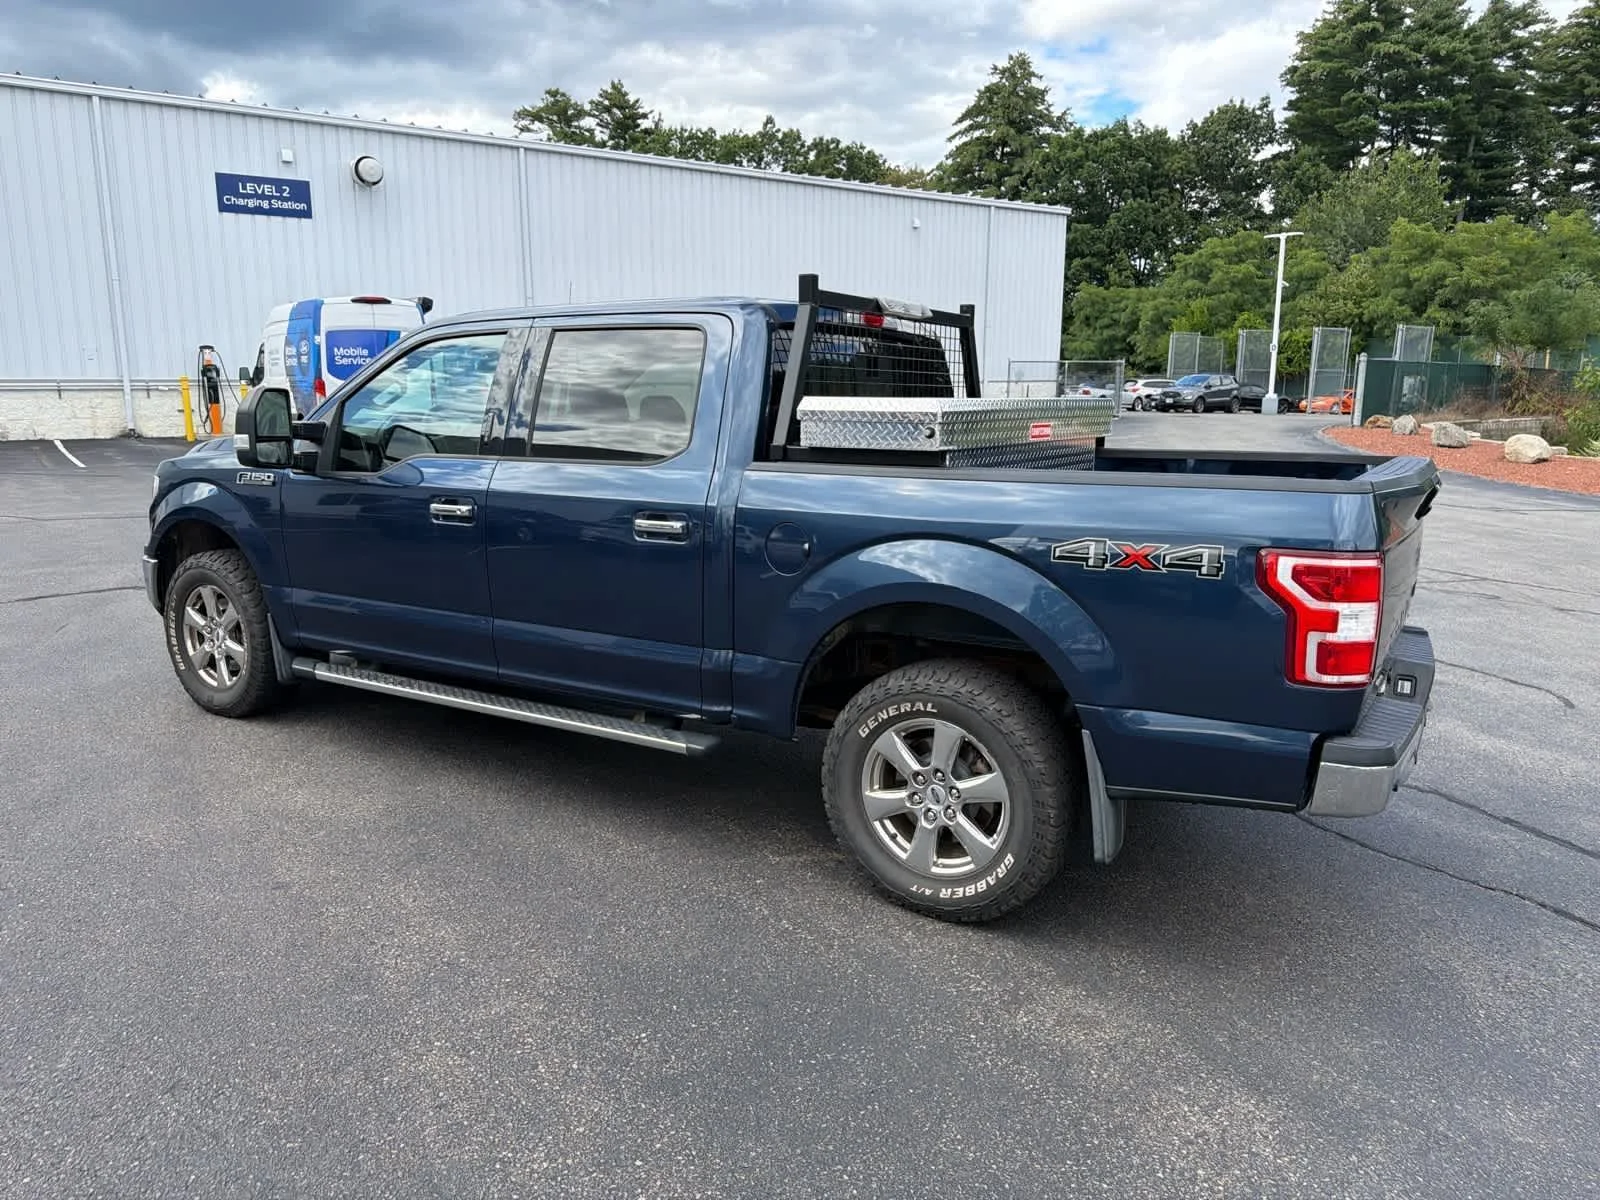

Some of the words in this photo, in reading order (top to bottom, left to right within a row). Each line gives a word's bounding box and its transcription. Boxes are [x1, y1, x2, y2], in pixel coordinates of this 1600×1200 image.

[238, 182, 280, 196] LEVEL
[282, 186, 290, 197] 2
[223, 195, 270, 209] Charging
[270, 199, 307, 211] Station
[334, 346, 369, 356] Mobile
[858, 701, 938, 738] GENERAL
[939, 852, 1015, 899] GRABBER
[909, 884, 934, 896] A/T
